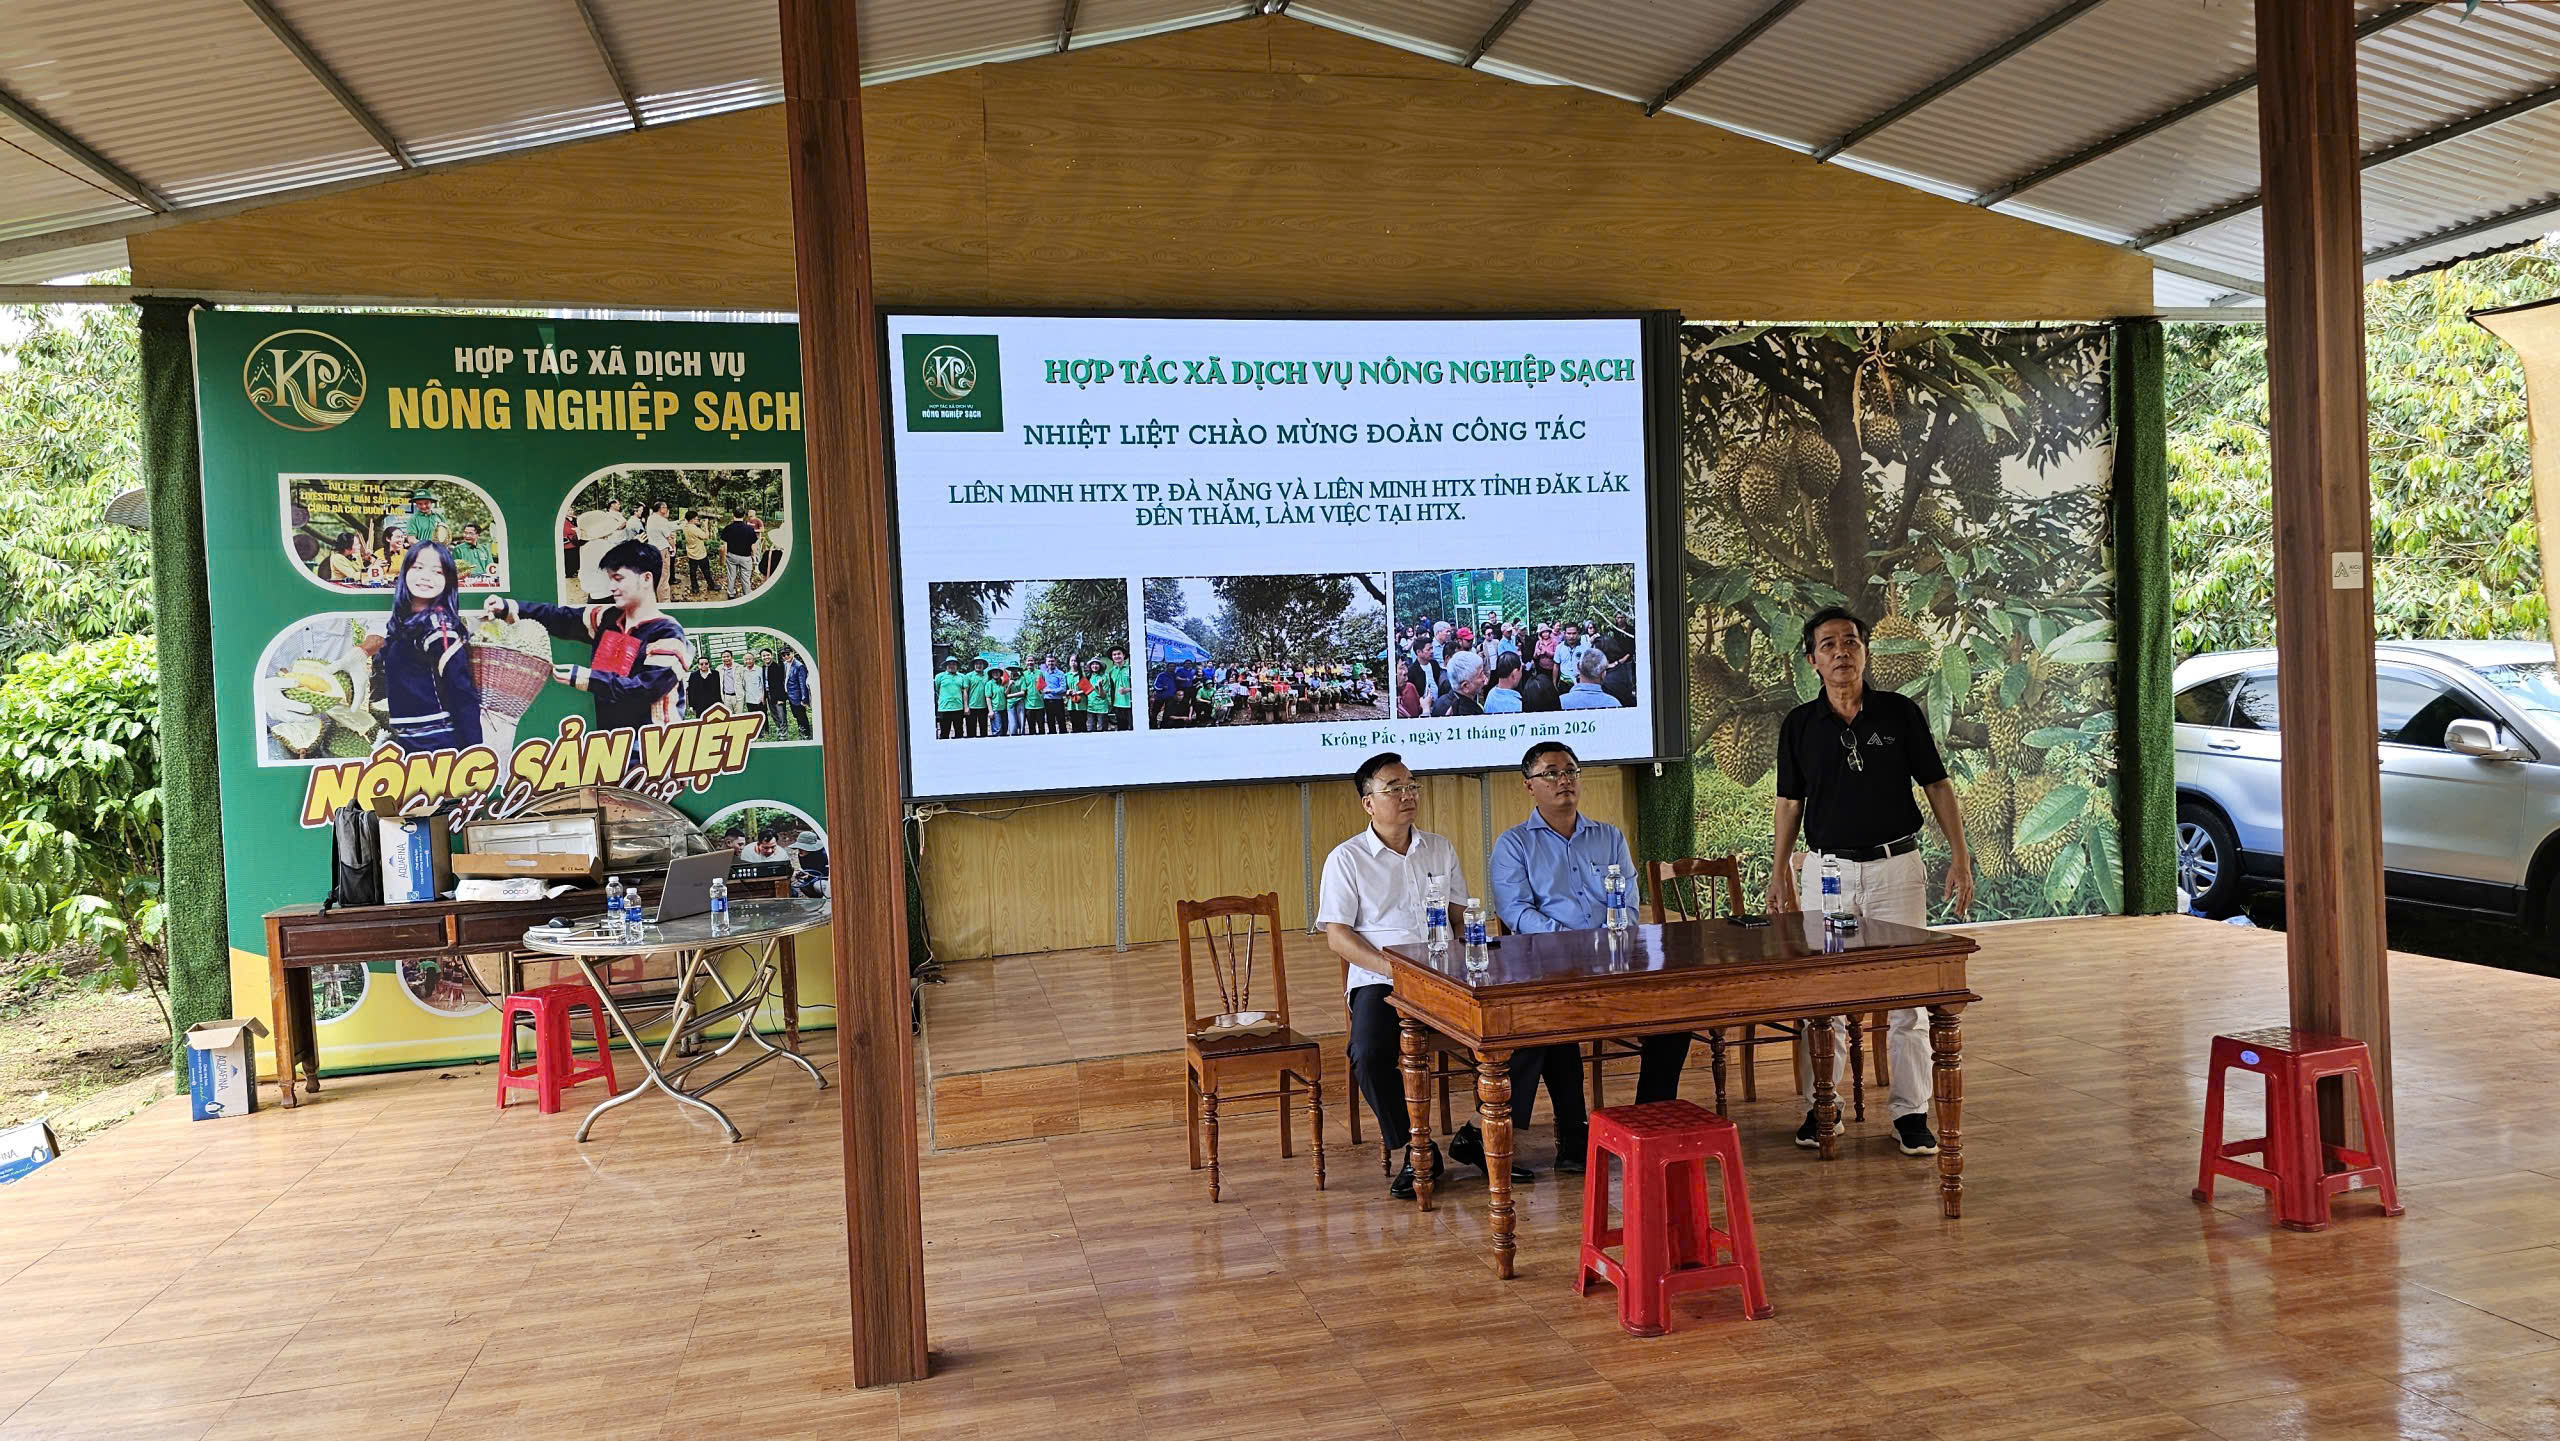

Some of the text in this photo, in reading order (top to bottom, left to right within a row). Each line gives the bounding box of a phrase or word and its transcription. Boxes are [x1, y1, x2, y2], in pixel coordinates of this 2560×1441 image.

[454, 343, 746, 383] HỢP TÁC XÃ DỊCH VỤ
[1044, 353, 1636, 391] HỢP TÁC XÃ DỊCH VỤ NÔNG NGHIỆP SẠCH
[387, 378, 801, 440] NÔNG NGHIỆP SẠCH
[1023, 414, 1586, 450] NHIỆT LIỆT CHÀO MỪNG ĐOÀN CÔNG TÁC
[948, 471, 1631, 504] LIÊN MINH HTX TP. ĐÀ NẴNG VÀ LIÊN MINH HTX TỈNH ĐĂK LĂK
[1135, 499, 1466, 529] ĐẾN THĂM, LÀM VIỆC TẠI HTX.
[1321, 731, 1368, 748] Krông
[1371, 726, 1396, 745] Pắc
[1409, 728, 1442, 745] ngày
[1447, 727, 1461, 741] 21
[1467, 725, 1507, 741] tháng
[1510, 723, 1526, 737] 07
[1530, 723, 1560, 736] năm
[1564, 720, 1596, 735] 2026
[302, 742, 498, 826] NÔNG
[505, 717, 634, 794] SẢN
[641, 704, 763, 792] VIỆT
[397, 841, 408, 879] AQUAFINA
[215, 1055, 229, 1093] AQUAFINA
